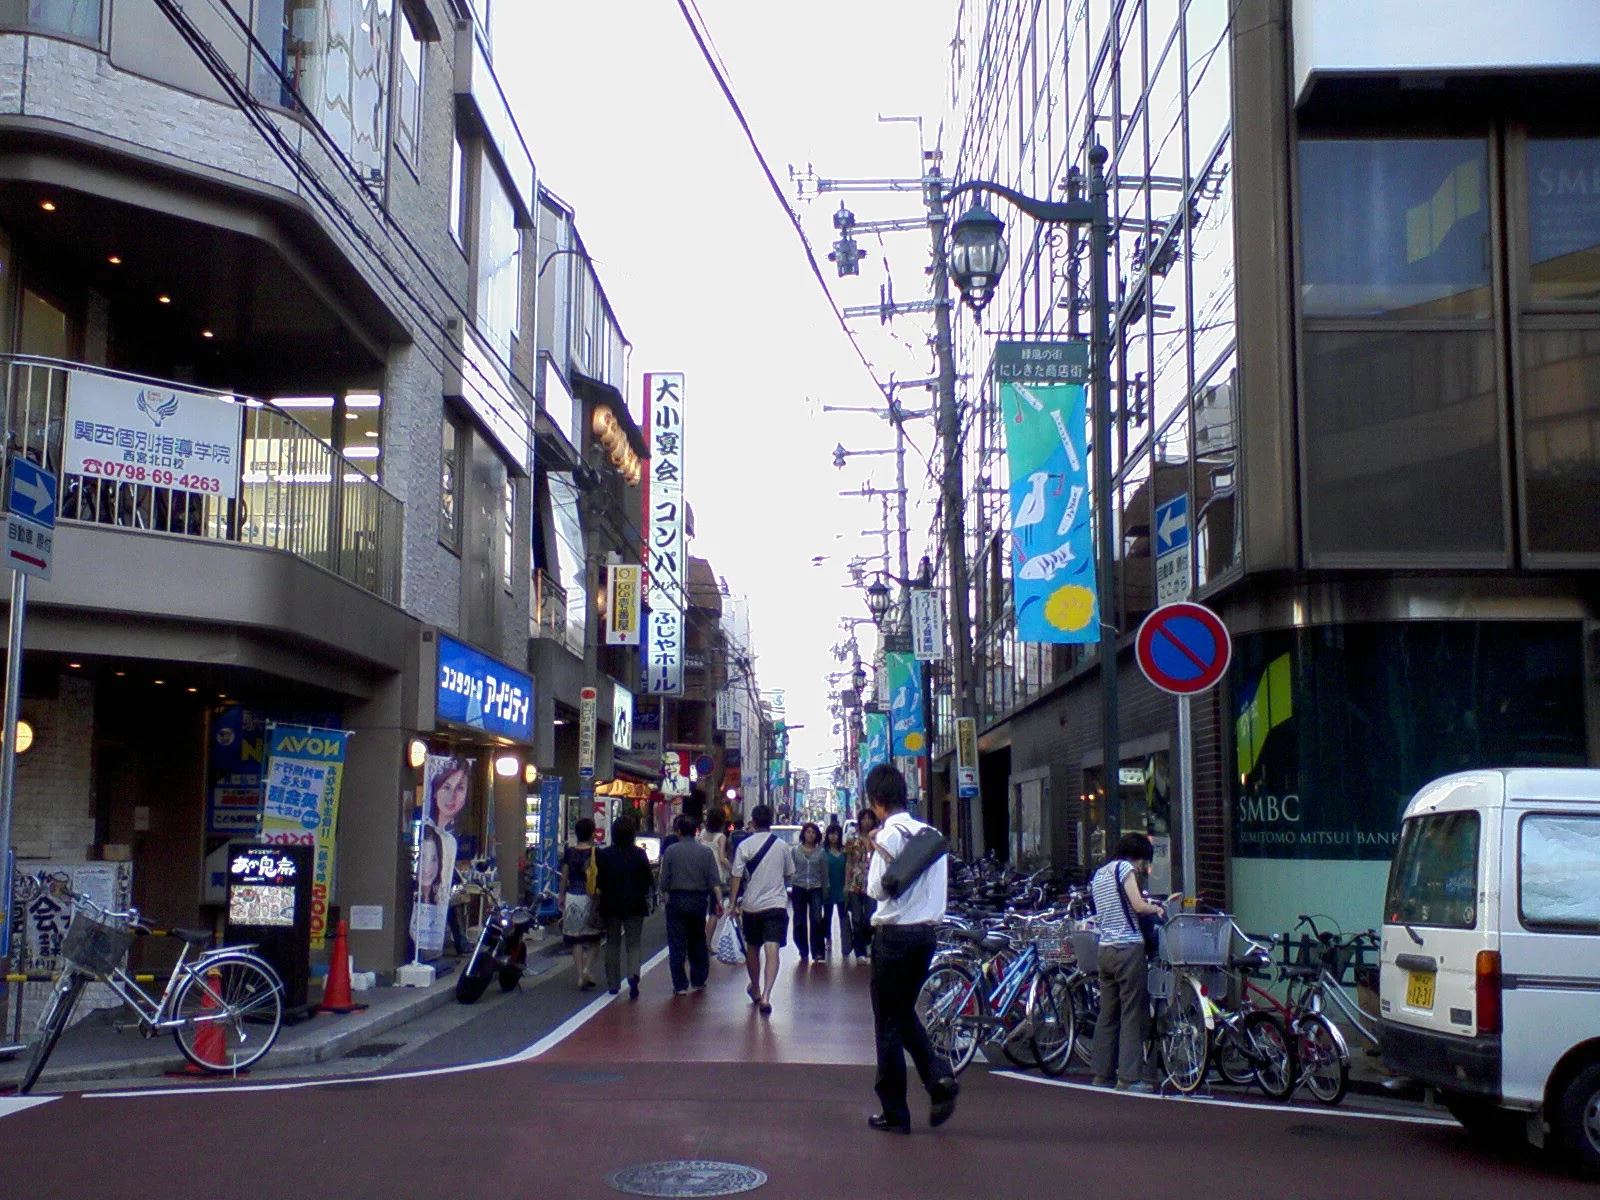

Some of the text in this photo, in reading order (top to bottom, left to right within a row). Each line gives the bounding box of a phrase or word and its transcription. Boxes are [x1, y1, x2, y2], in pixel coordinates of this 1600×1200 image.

[1000, 363, 1082, 378] にしきた商店街
[73, 419, 231, 465] 関西個別指導学院
[122, 449, 185, 472] 西宮北口校
[102, 462, 221, 493] 0798-69-4263
[653, 611, 677, 692] ふじやホール
[1239, 794, 1300, 822] SMBC
[1299, 831, 1350, 844] MITSUI
